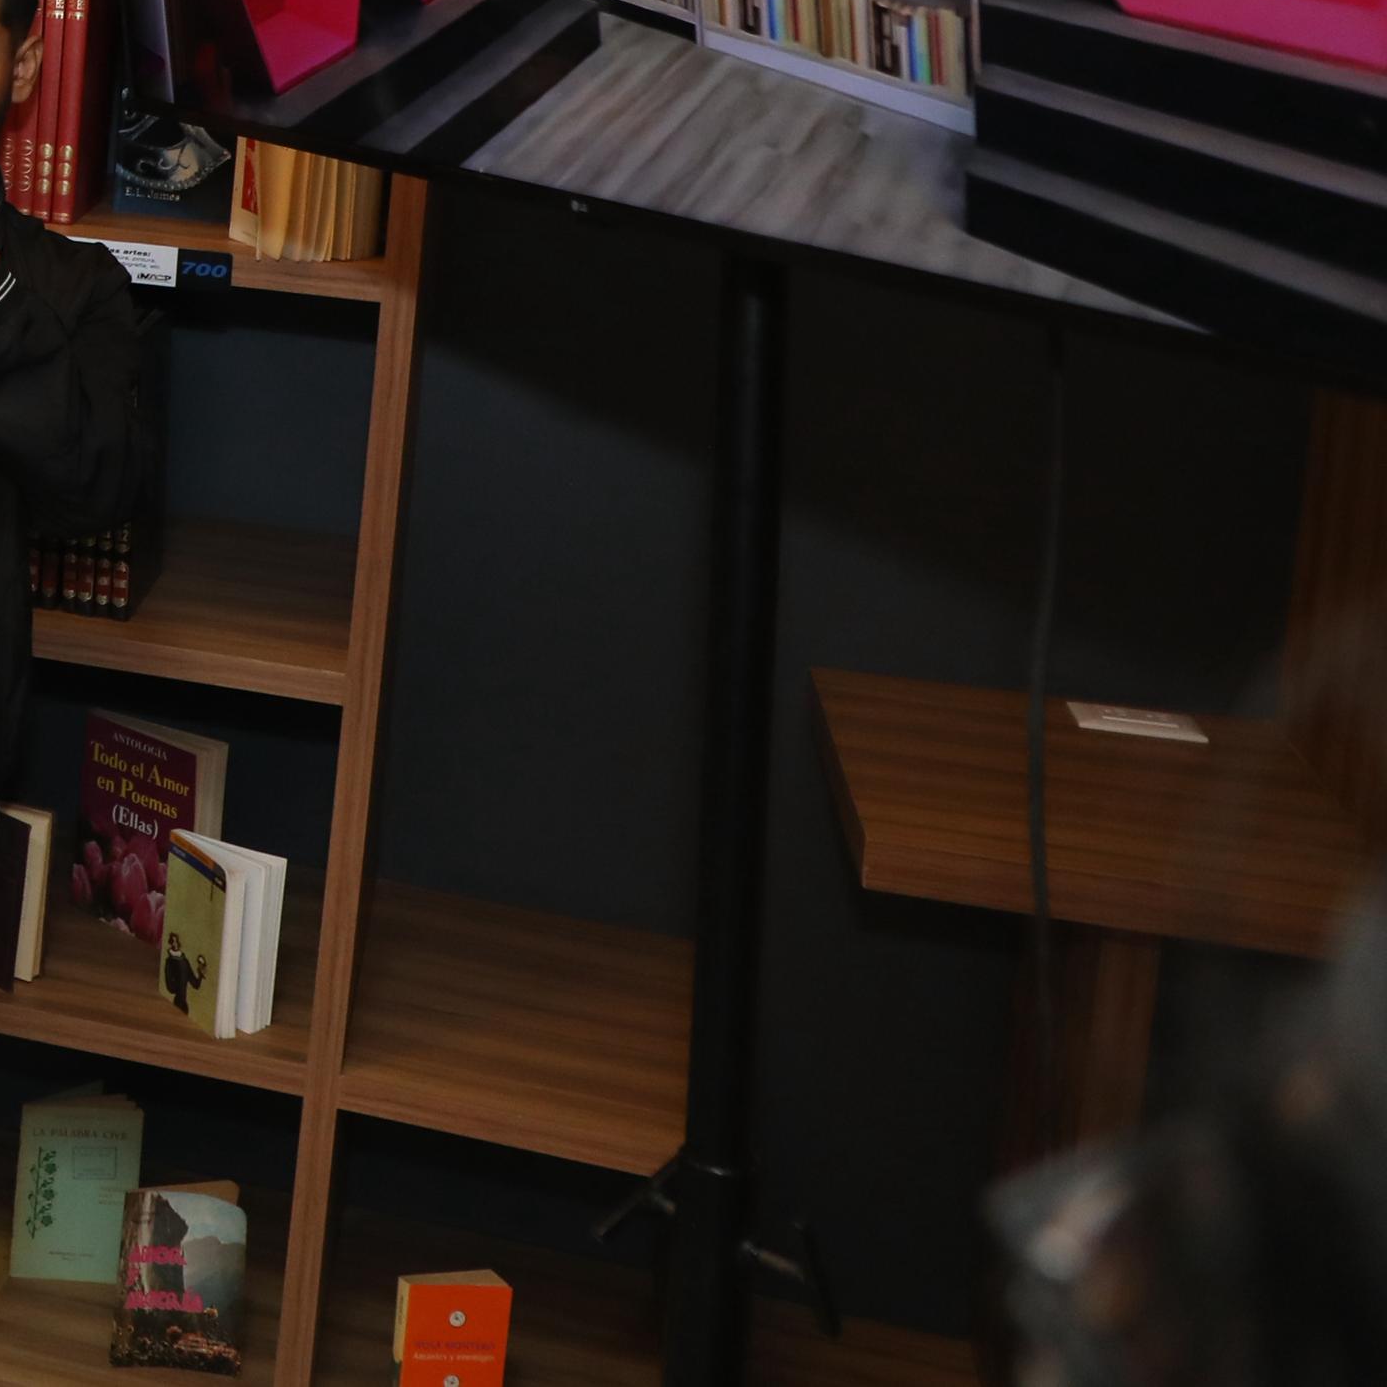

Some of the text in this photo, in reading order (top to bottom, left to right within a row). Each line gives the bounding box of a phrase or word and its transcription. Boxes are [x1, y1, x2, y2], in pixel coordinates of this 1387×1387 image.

[182, 261, 227, 278] 700
[90, 740, 190, 797] Todo el Amor
[97, 775, 178, 819] en Poemas
[112, 804, 159, 841] (Ellas)
